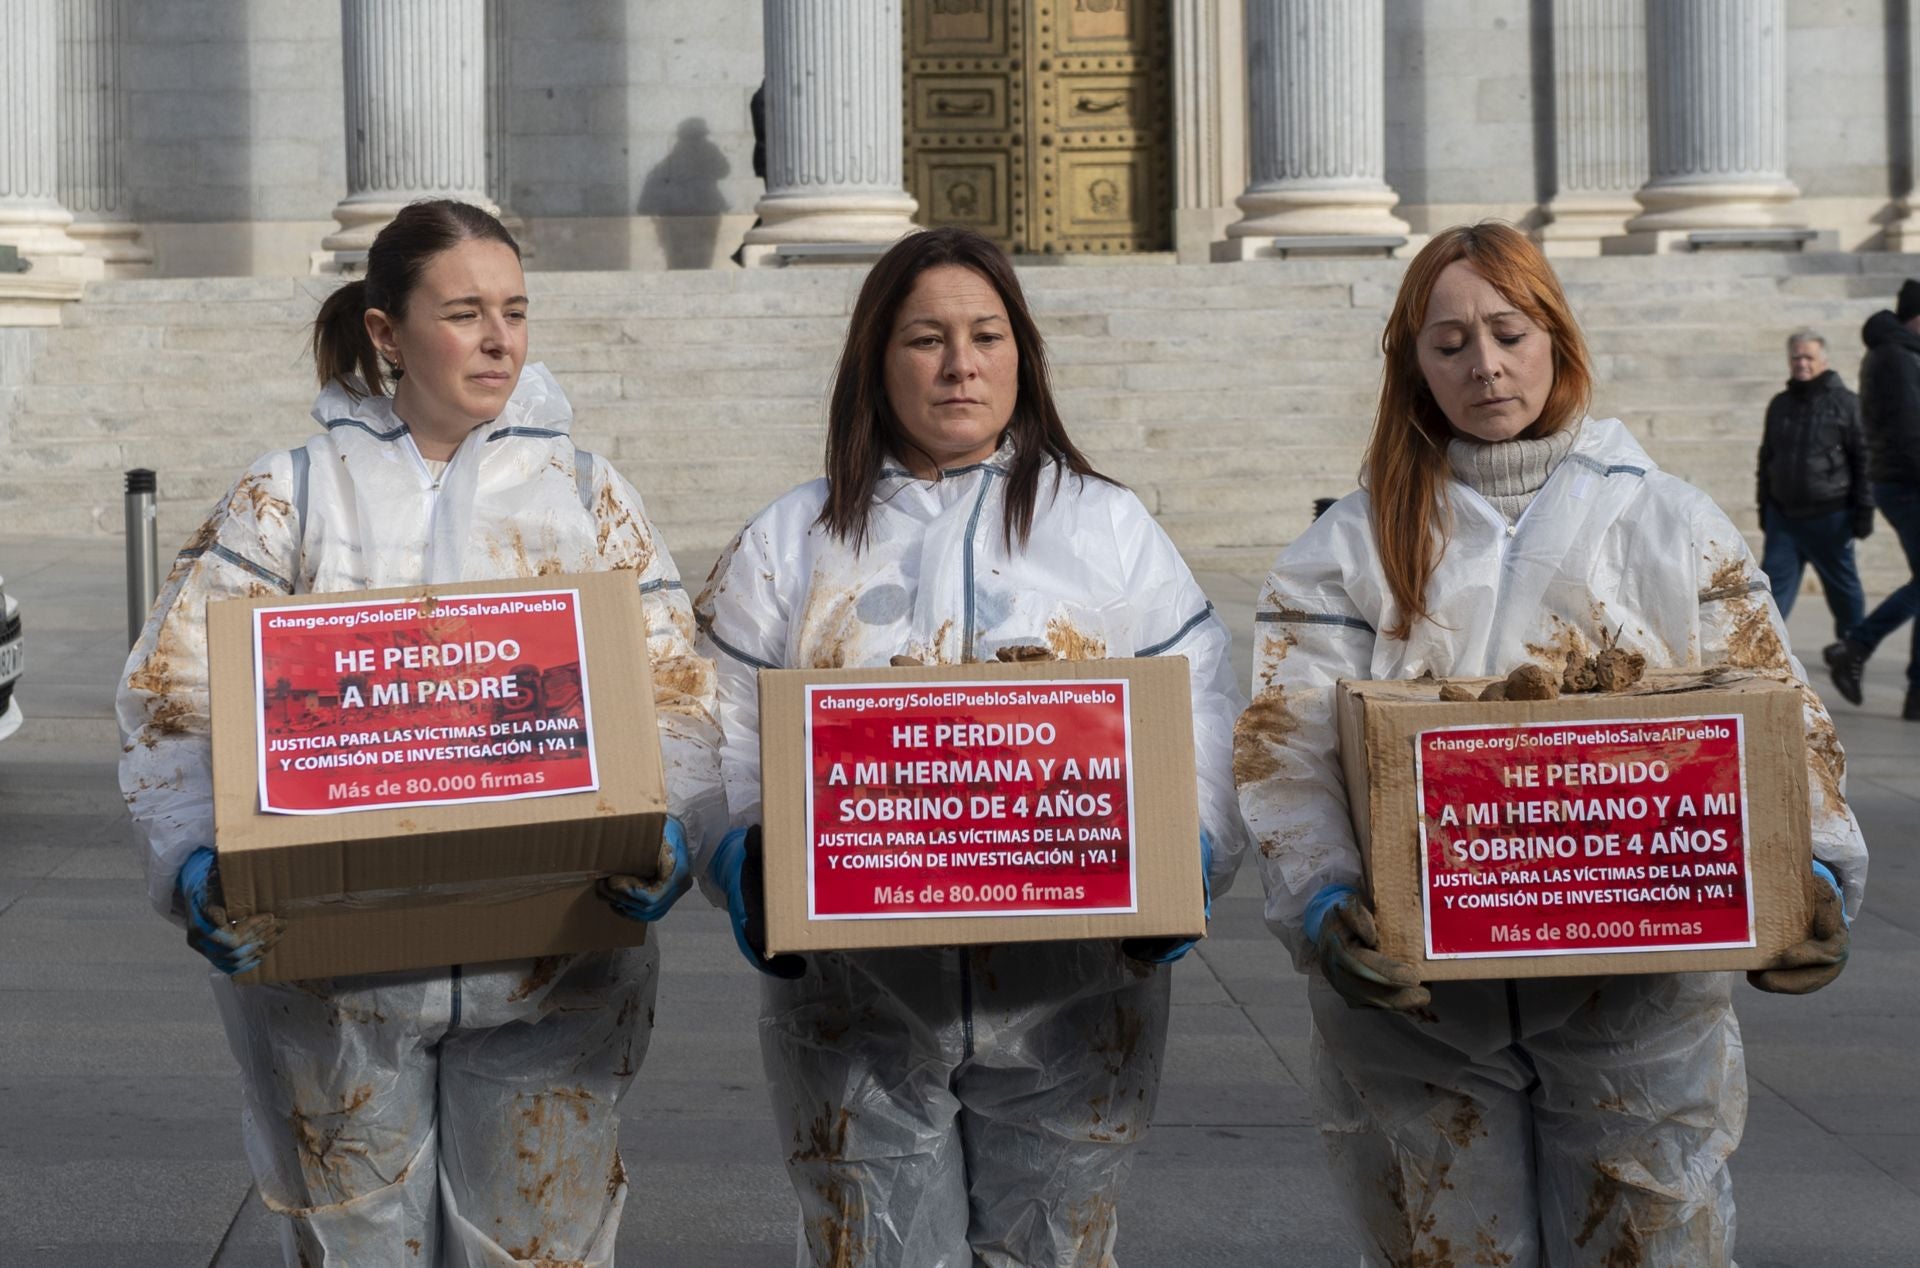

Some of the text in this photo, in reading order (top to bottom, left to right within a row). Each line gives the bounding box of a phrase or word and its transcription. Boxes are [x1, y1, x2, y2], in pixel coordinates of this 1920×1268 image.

[335, 639, 521, 673] HE PERDIDO
[341, 675, 519, 709] A MI PADRE
[820, 690, 1116, 712] change.org/SoloElPuebloSalvaAlPueblo
[270, 718, 579, 752] JUSTICIA PARA LAS VÍCTIMAS DE LA DANA
[892, 722, 1057, 748] HE PERDIDO
[1429, 725, 1730, 752] change.org/SoloElPuebloSalvaAlPueblo
[280, 758, 293, 771] Y
[294, 751, 378, 770] COMISIÓN
[382, 751, 404, 764] DE
[407, 740, 532, 763] INVESTIGACIÓN
[328, 770, 544, 800] Más de 80.000 firmas
[828, 757, 1121, 786] A MI HERMANA Y A MI
[1503, 760, 1670, 788] HE PERDIDO
[839, 789, 1113, 822] SOBRINO DE 4 AÑOS
[1440, 793, 1736, 827] A MI HERMANO Y A MI
[817, 828, 1121, 848] JUSTICIA PARA LAS VÍCTIMAS DE LA DANA
[1453, 826, 1728, 861] SOBRINO DE 4 AÑOS
[828, 856, 841, 869] Y
[842, 851, 923, 869] COMISIÓN
[927, 854, 948, 867] DE
[951, 847, 1074, 866] INVESTIGACIÓN
[1433, 862, 1737, 887] JUSTICIA PARA LAS VÍCTIMAS DE LA DANA
[874, 882, 1085, 904] Más de 80.000 firmas
[1444, 896, 1458, 909] Y
[1458, 889, 1538, 908] COMISIÓN
[1542, 892, 1564, 905] DE
[1566, 885, 1690, 904] INVESTIGACIÓN
[1491, 919, 1702, 942] Más de 80.000 firmas
